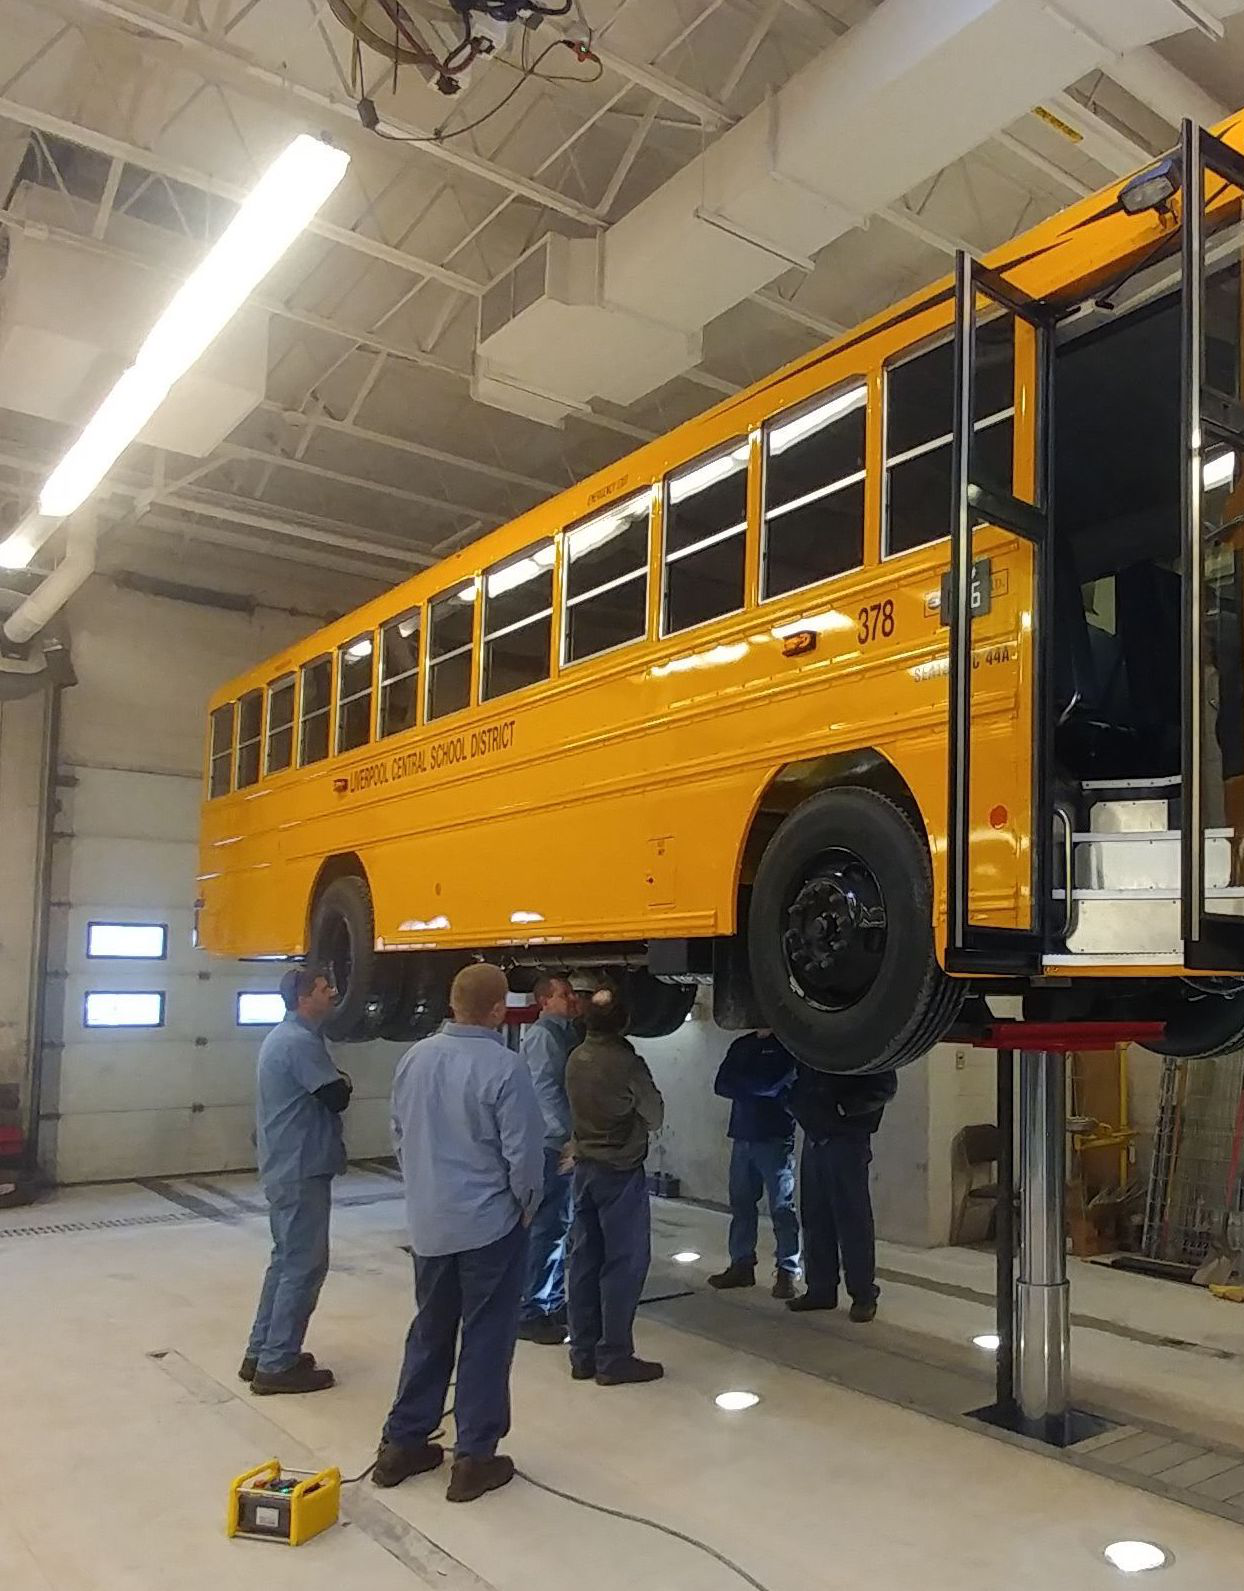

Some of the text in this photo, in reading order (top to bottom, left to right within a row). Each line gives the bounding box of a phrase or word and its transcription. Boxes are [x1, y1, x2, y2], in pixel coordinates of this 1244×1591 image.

[857, 599, 895, 645] 378
[985, 645, 1010, 665] 44A
[350, 720, 515, 793] LIVERPOOL CENTRAL SCHOOL DISTRICT
